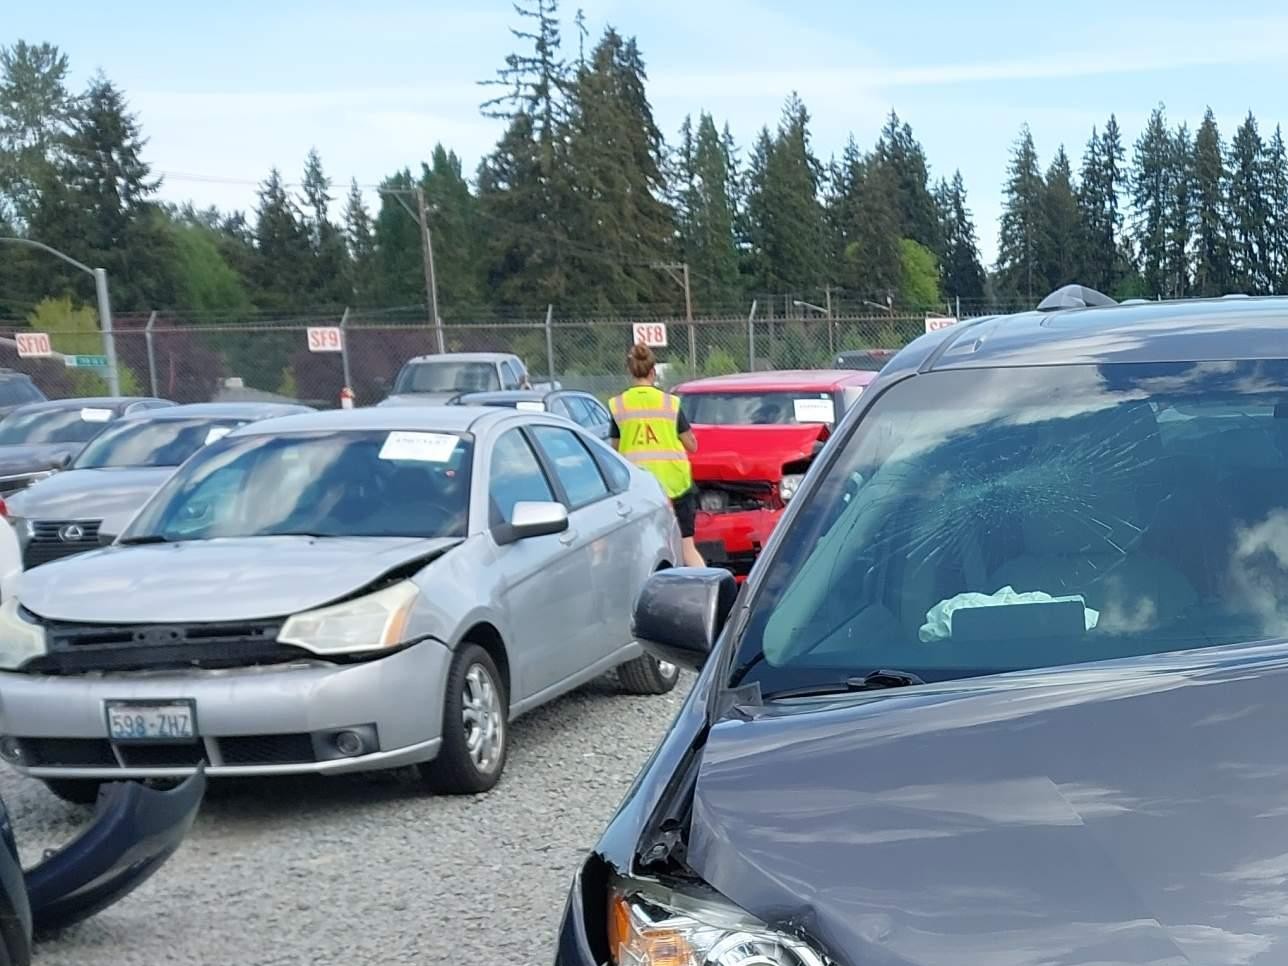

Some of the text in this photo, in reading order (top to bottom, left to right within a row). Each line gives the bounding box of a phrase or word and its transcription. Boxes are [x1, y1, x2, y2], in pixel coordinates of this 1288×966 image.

[311, 330, 338, 347] SF9
[637, 326, 663, 343] SF8
[19, 335, 49, 353] SF10
